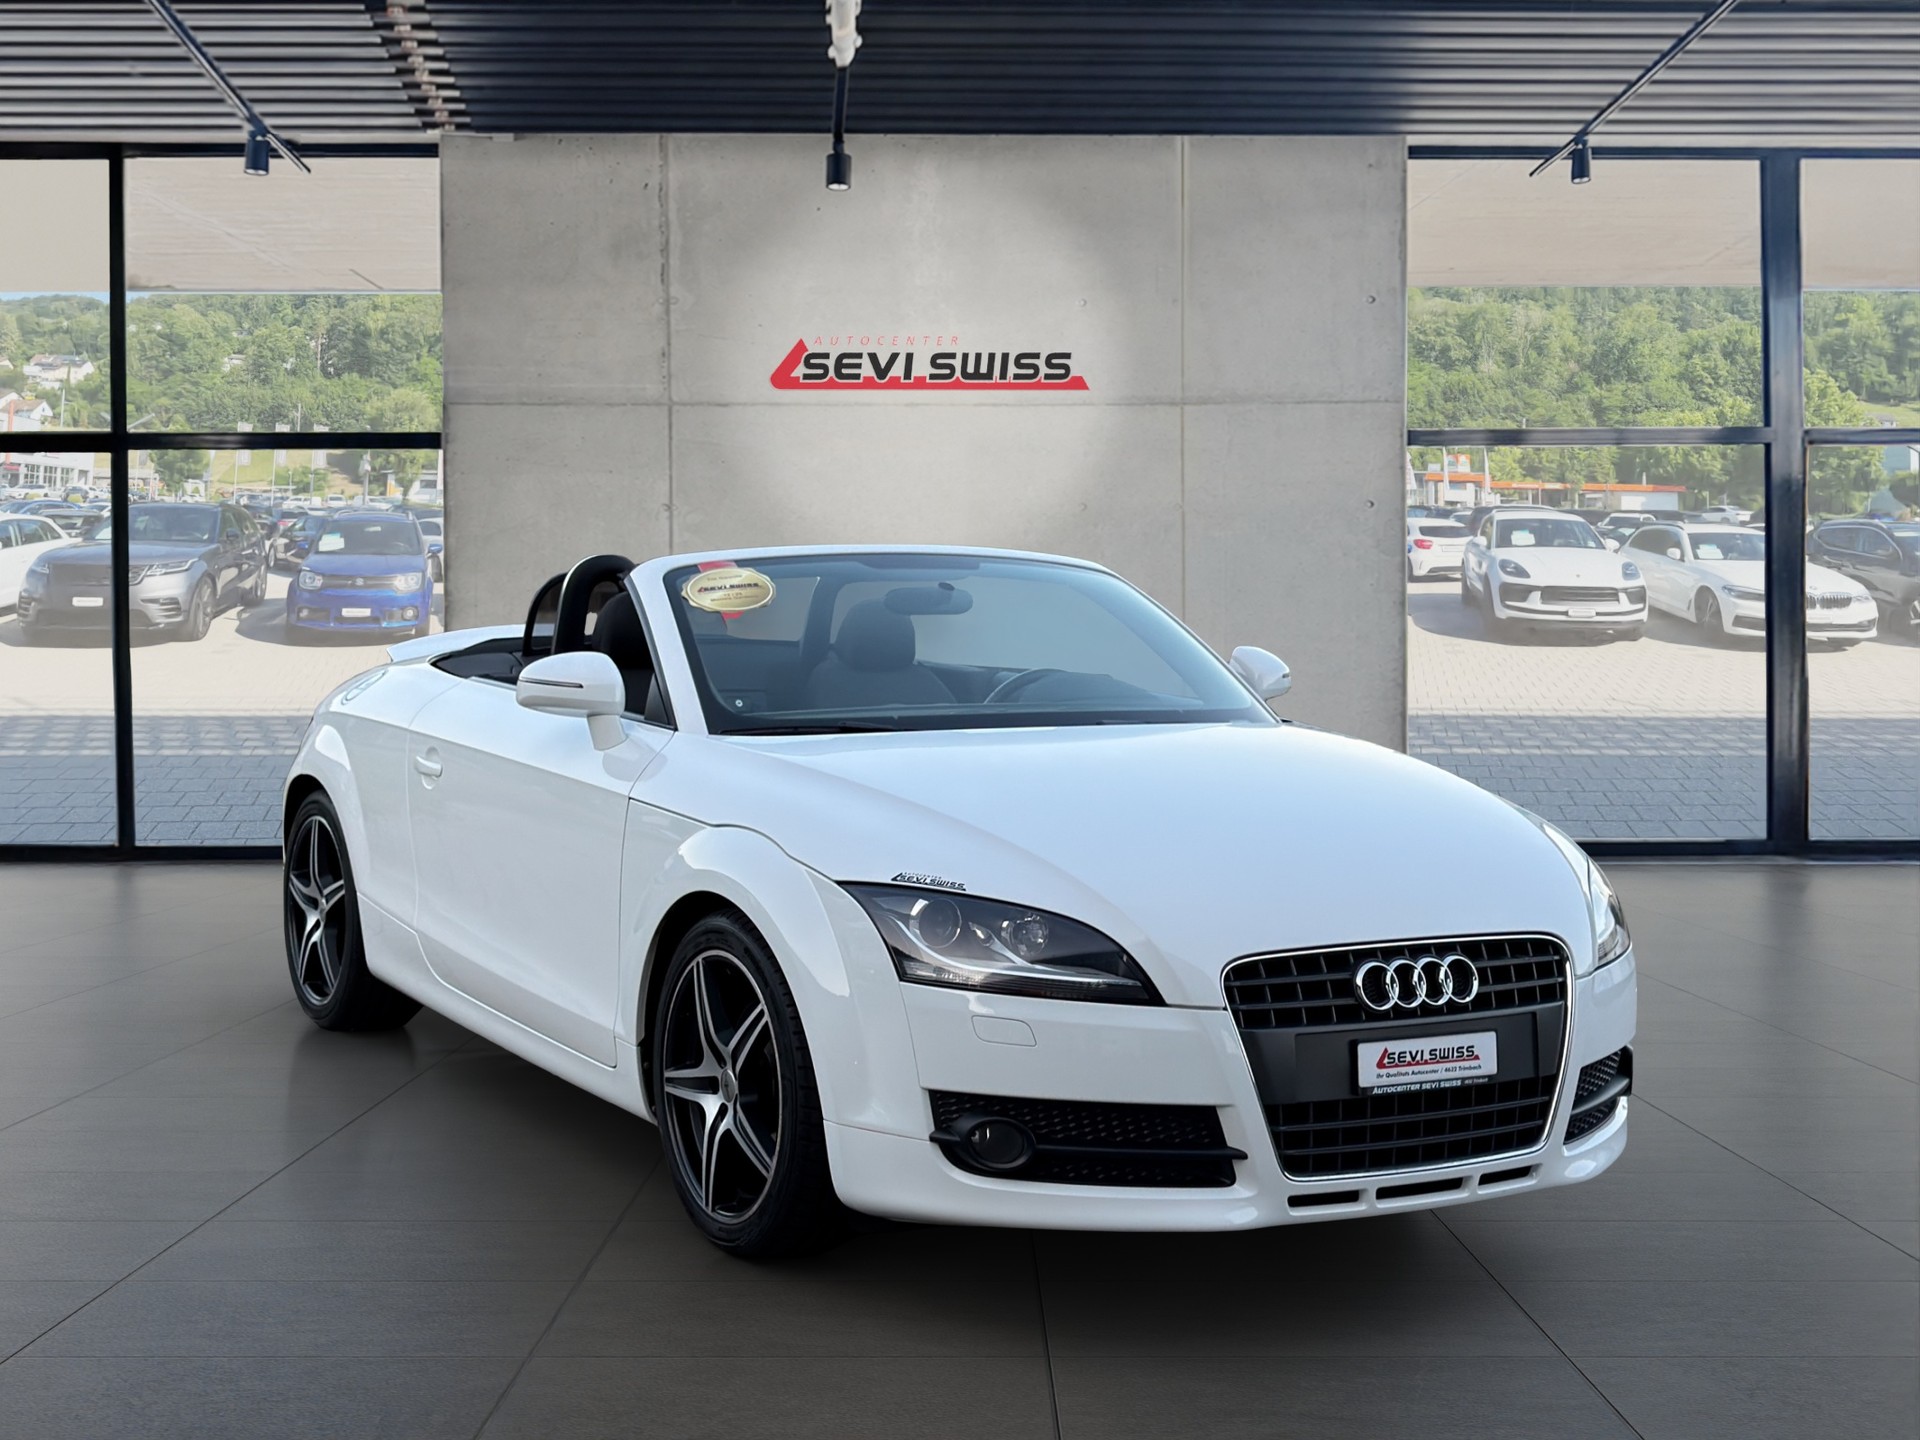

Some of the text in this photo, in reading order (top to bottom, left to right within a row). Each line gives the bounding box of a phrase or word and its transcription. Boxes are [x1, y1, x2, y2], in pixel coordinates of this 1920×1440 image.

[813, 335, 960, 346] AUTOCENTER
[801, 352, 1072, 381] SEVI SWISS
[899, 875, 965, 889] SEVI SWISS
[1386, 1045, 1475, 1064] SEVI SWISS
[1411, 1068, 1439, 1076] Autocenter
[1421, 1082, 1439, 1090] SEVI
[1440, 1079, 1462, 1088] SWISS
